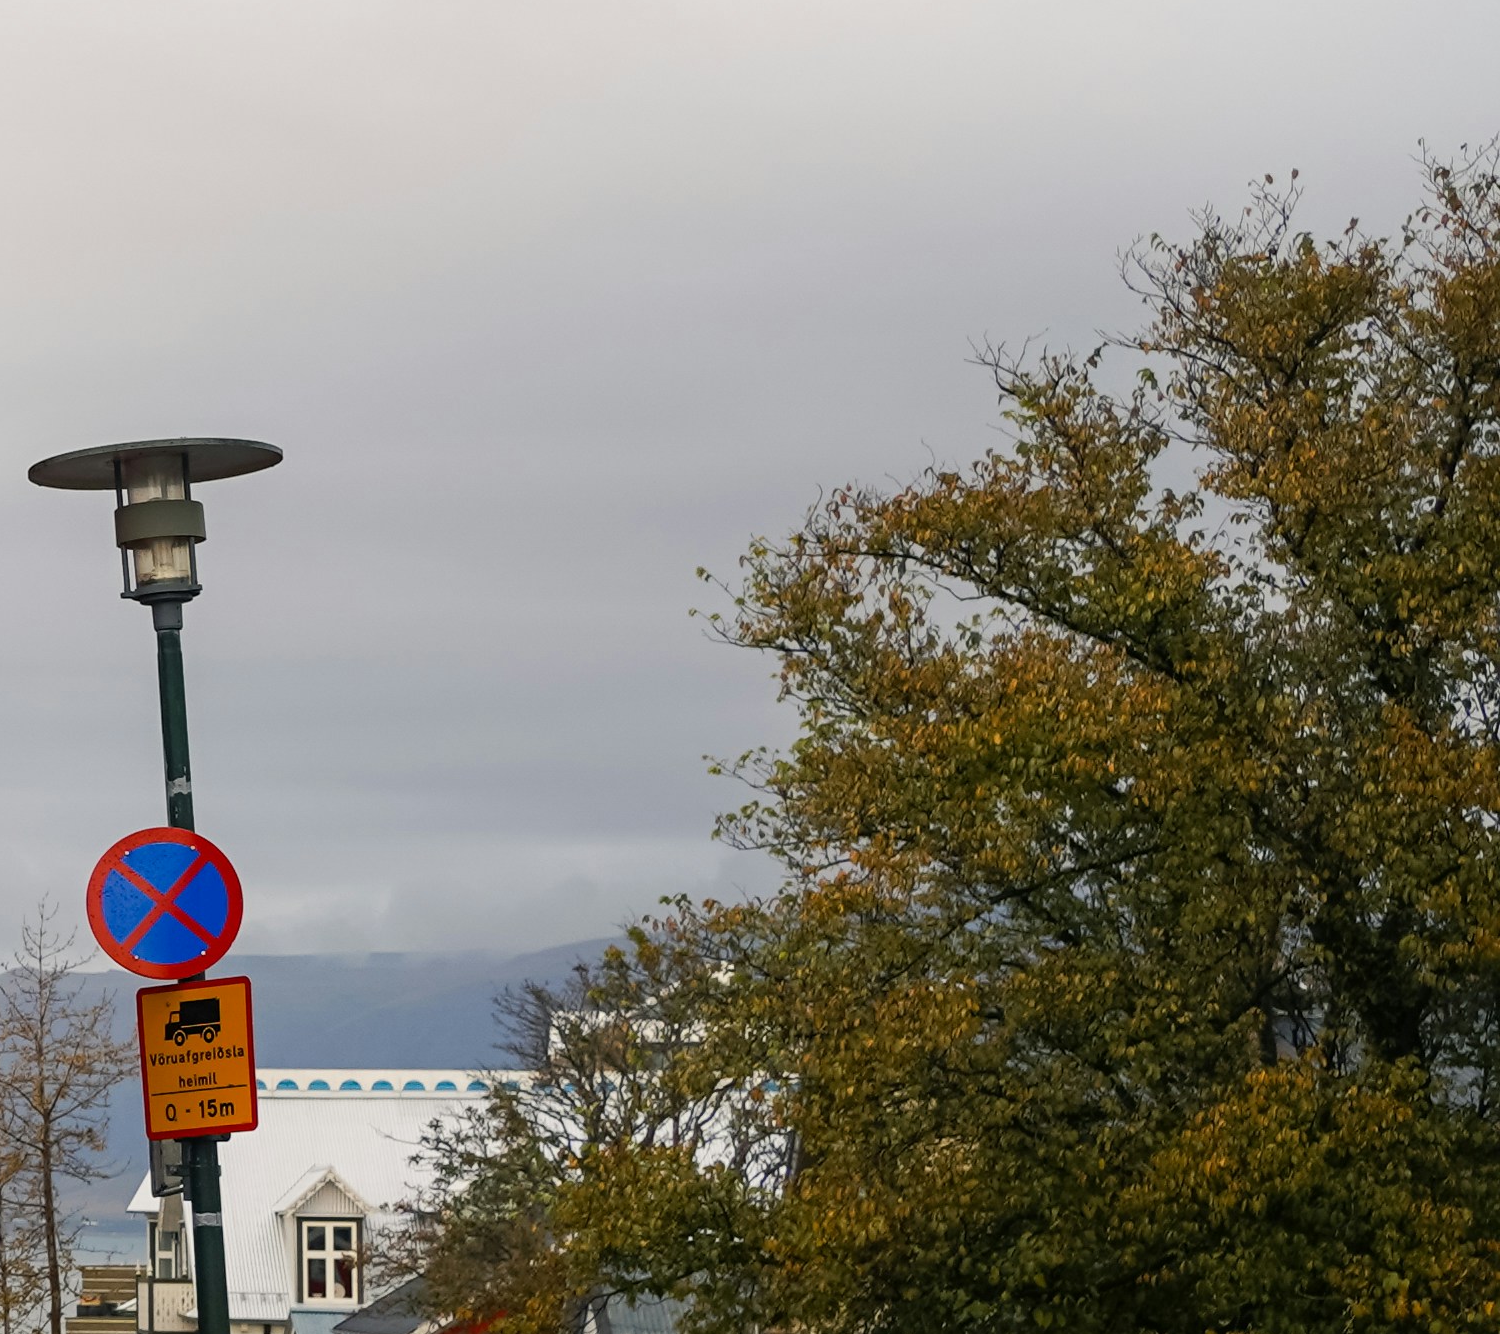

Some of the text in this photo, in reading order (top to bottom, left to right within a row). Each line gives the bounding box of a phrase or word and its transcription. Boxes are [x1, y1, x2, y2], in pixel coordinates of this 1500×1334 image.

[150, 1045, 244, 1066] Vöruafgreiðsla
[179, 1072, 217, 1088] heimil
[199, 1099, 234, 1118] 15m
